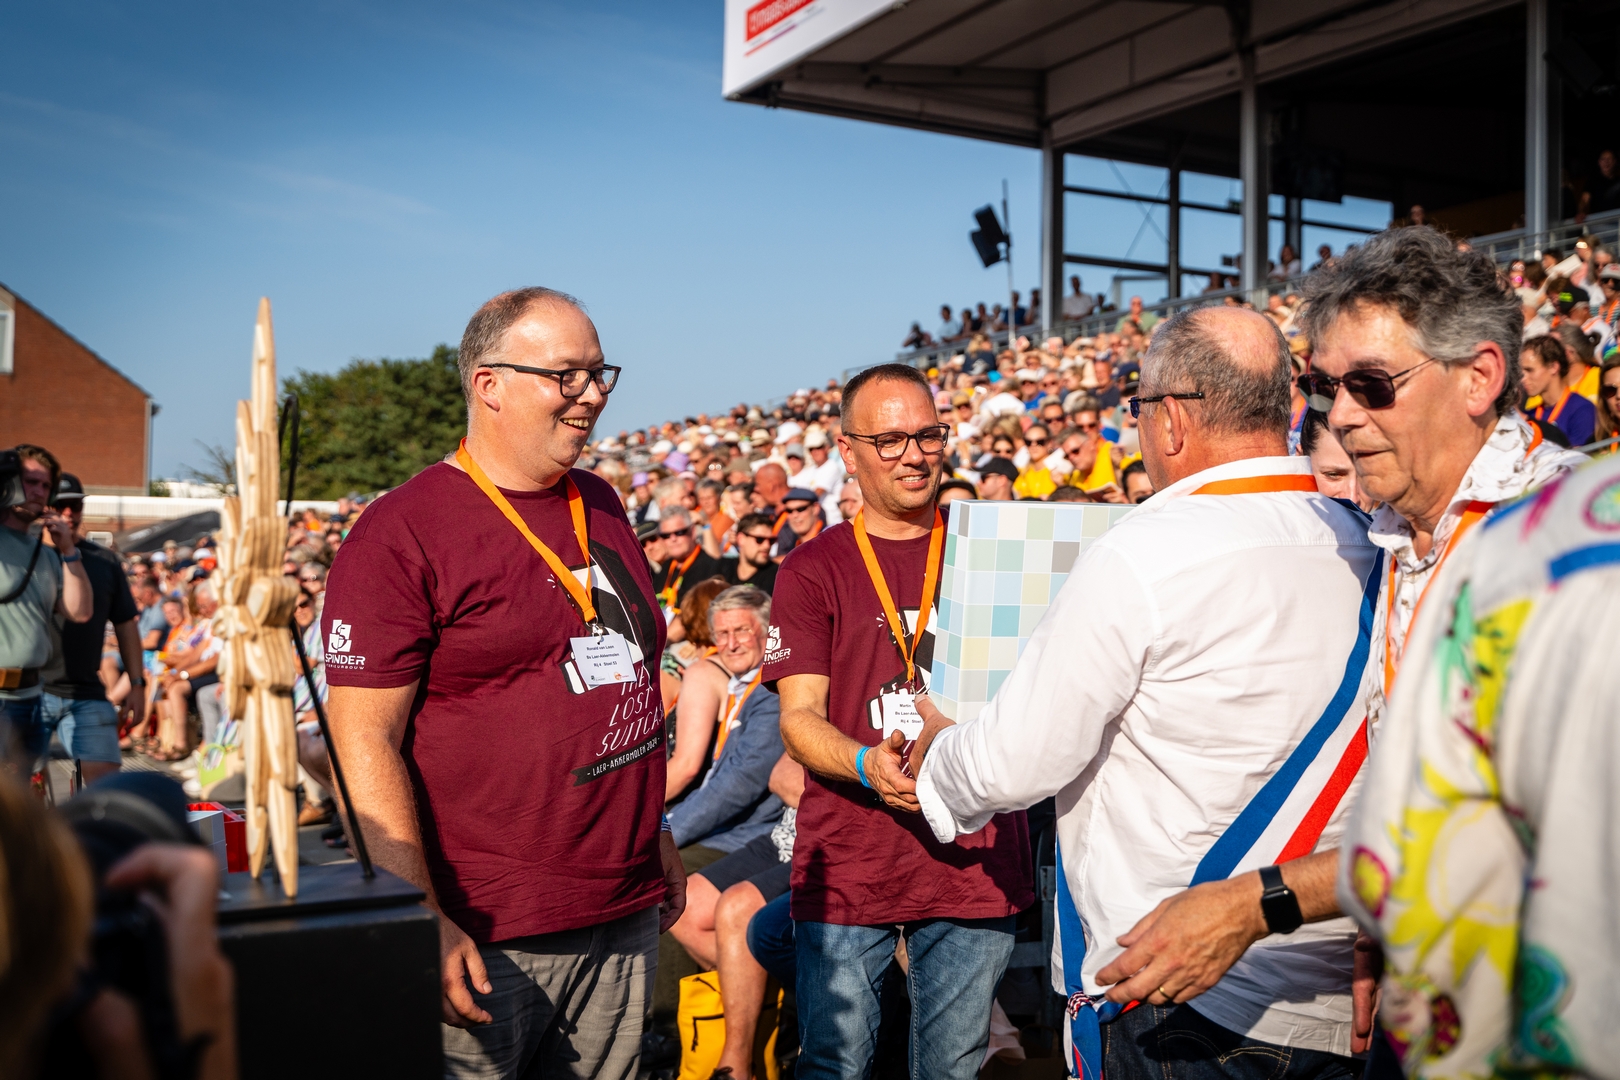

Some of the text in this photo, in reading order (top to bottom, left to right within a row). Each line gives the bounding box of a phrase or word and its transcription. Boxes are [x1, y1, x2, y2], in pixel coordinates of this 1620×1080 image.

[764, 648, 791, 662] INDER
[609, 688, 652, 727] LOST
[596, 700, 664, 757] SUITCAS
[592, 748, 647, 777] LAER-AKKERMOLEN
